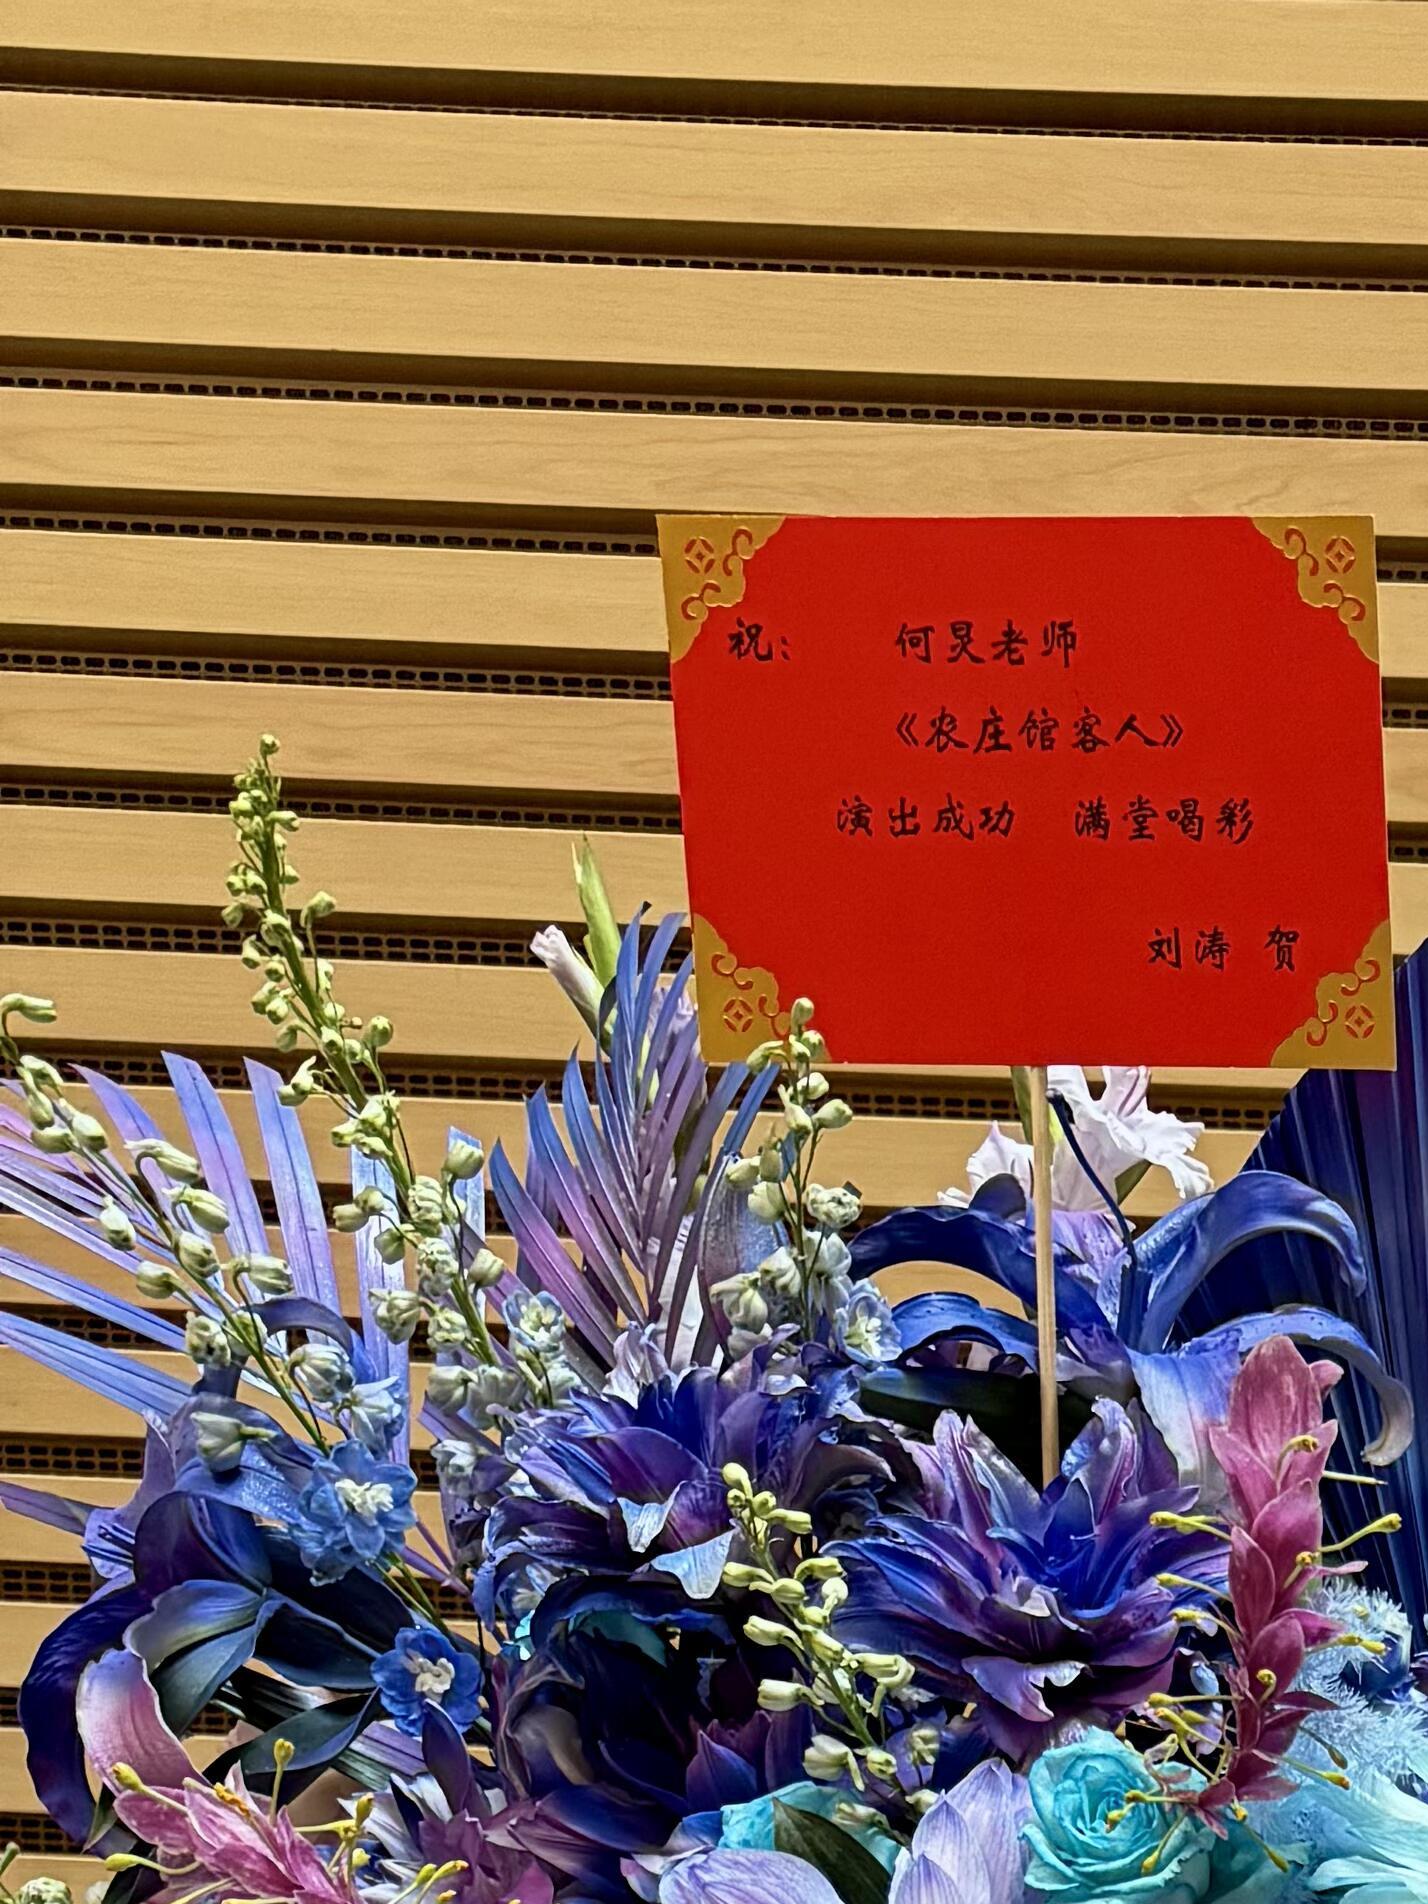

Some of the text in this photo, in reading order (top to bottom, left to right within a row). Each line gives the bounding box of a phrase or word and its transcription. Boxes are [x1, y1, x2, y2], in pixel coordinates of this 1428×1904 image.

[895, 619, 1077, 669] 何炅老师
[896, 705, 1183, 754] 《农庄馆客人》
[836, 793, 1254, 845] 演出成功 满堂喝彩
[1147, 924, 1300, 972] 刘涛 贺
